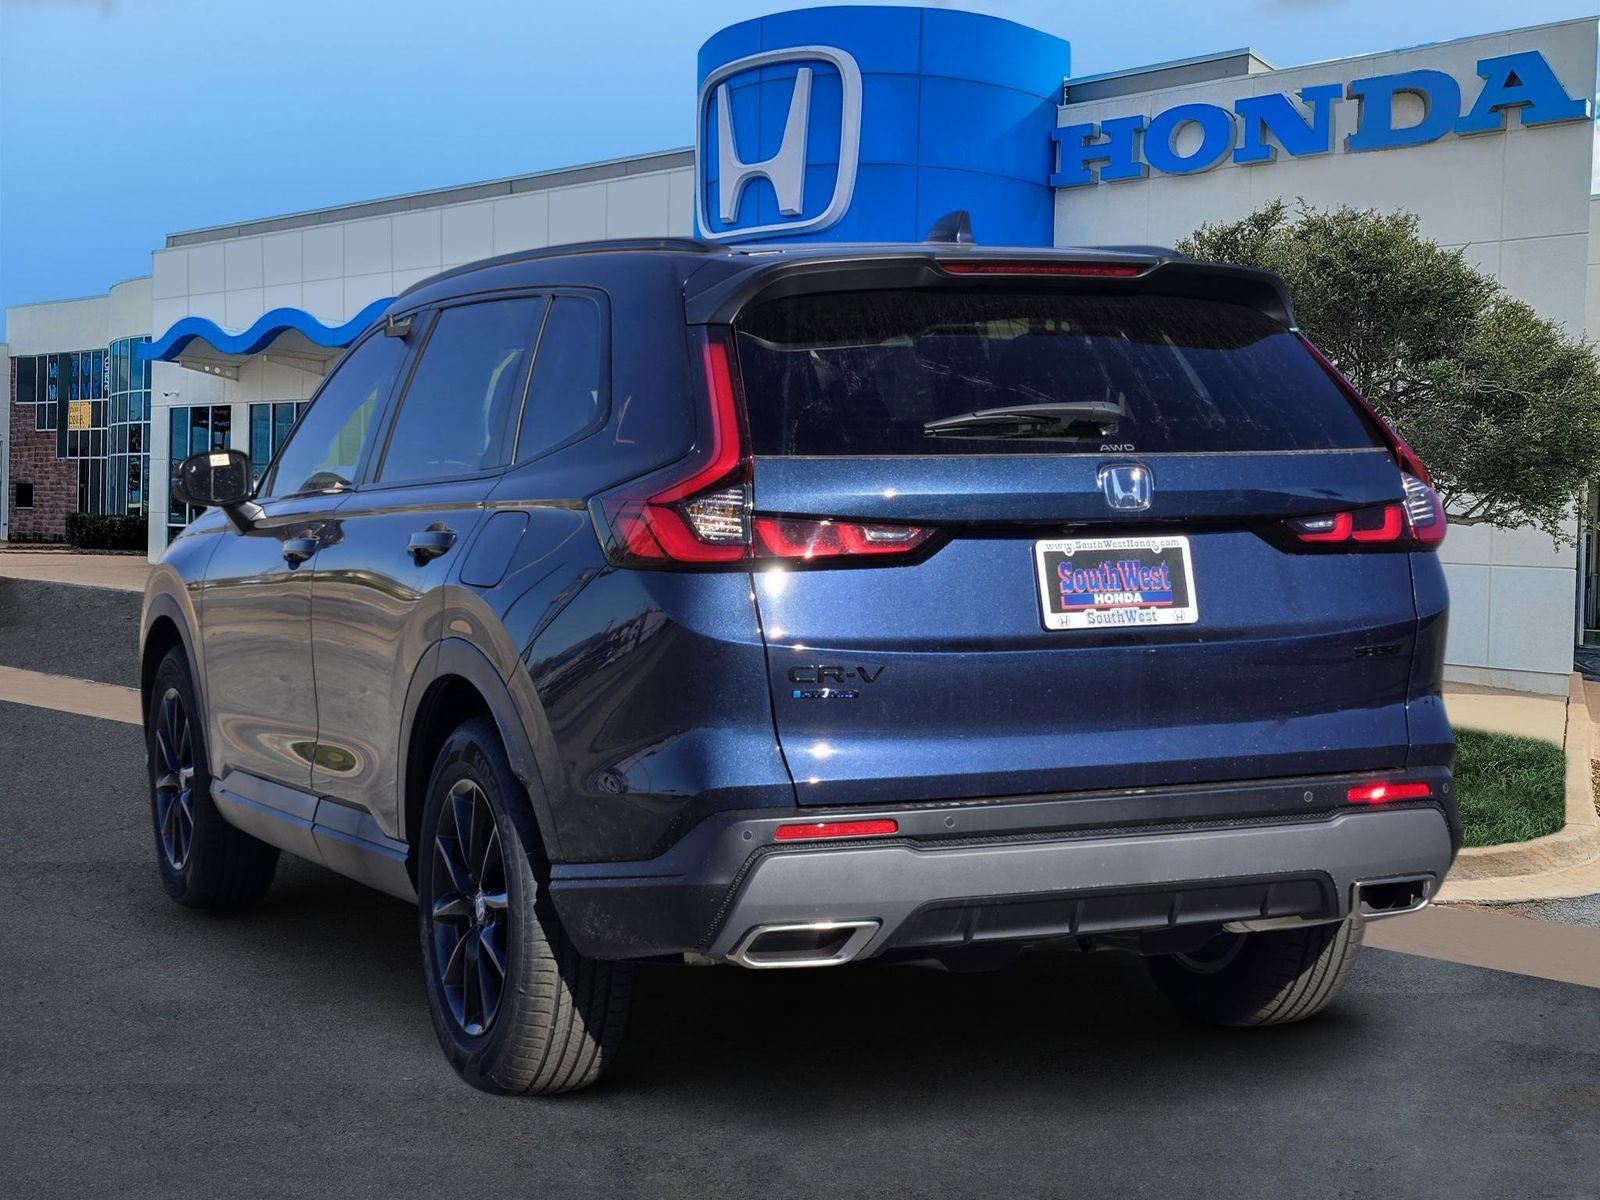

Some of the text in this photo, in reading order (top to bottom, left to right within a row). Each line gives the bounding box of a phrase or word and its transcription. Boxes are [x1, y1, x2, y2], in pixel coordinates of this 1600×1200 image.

[1050, 49, 1591, 188] HONDA
[1100, 443, 1136, 452] AWD
[1057, 559, 1172, 594] SouthWest
[1093, 592, 1145, 605] HONDA
[1086, 610, 1159, 625] SouthWest
[787, 664, 886, 684] CR-V
